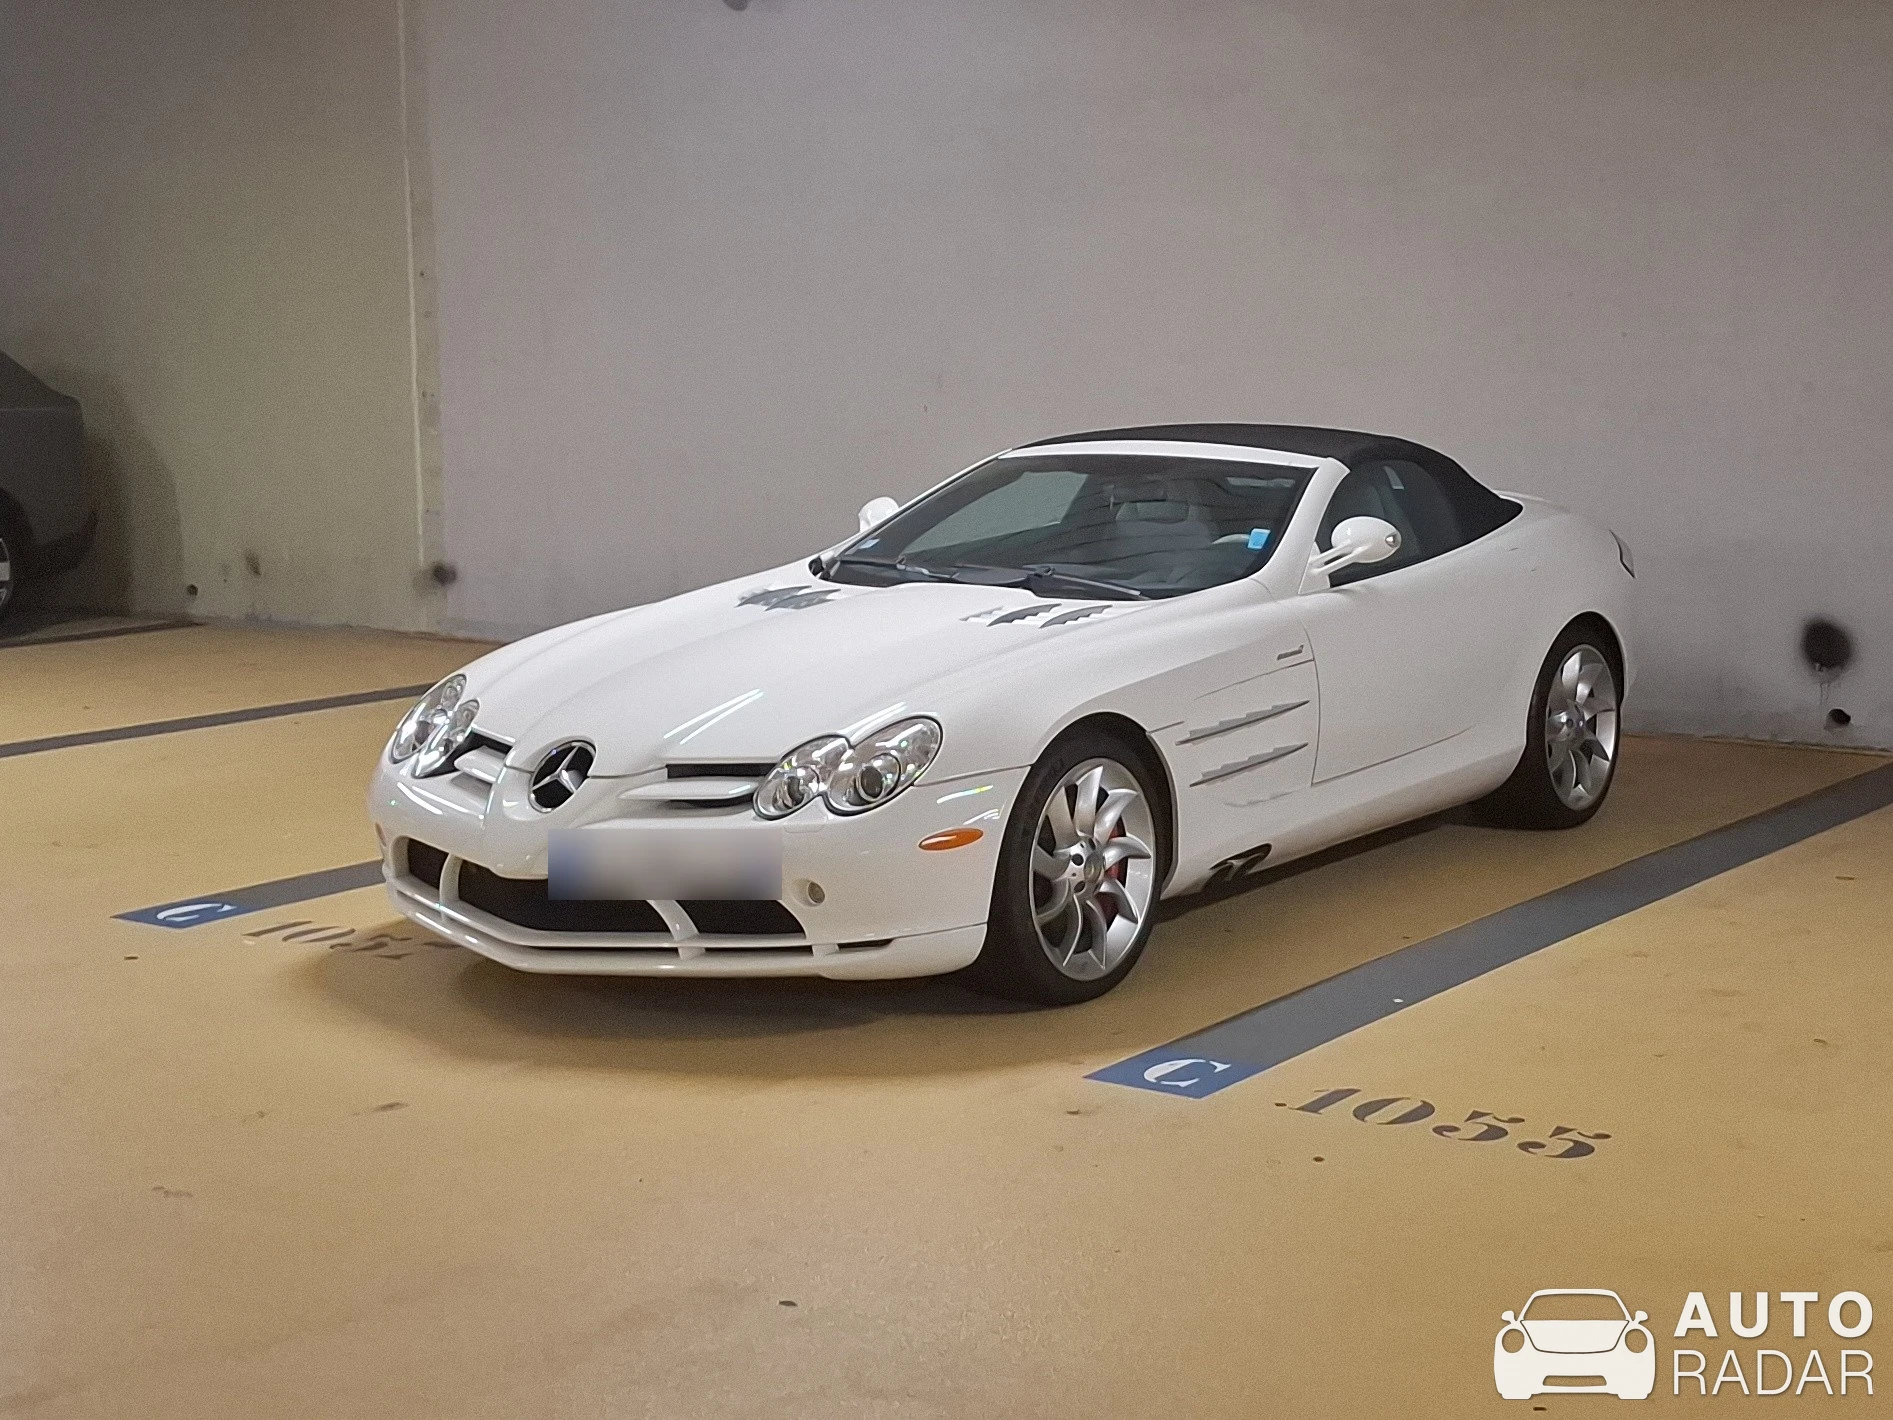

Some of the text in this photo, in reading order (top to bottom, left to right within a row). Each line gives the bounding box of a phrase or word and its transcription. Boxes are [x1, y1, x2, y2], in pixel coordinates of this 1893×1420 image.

[156, 902, 234, 922] C
[1143, 1058, 1232, 1088] C
[1288, 1087, 1612, 1159] 1055
